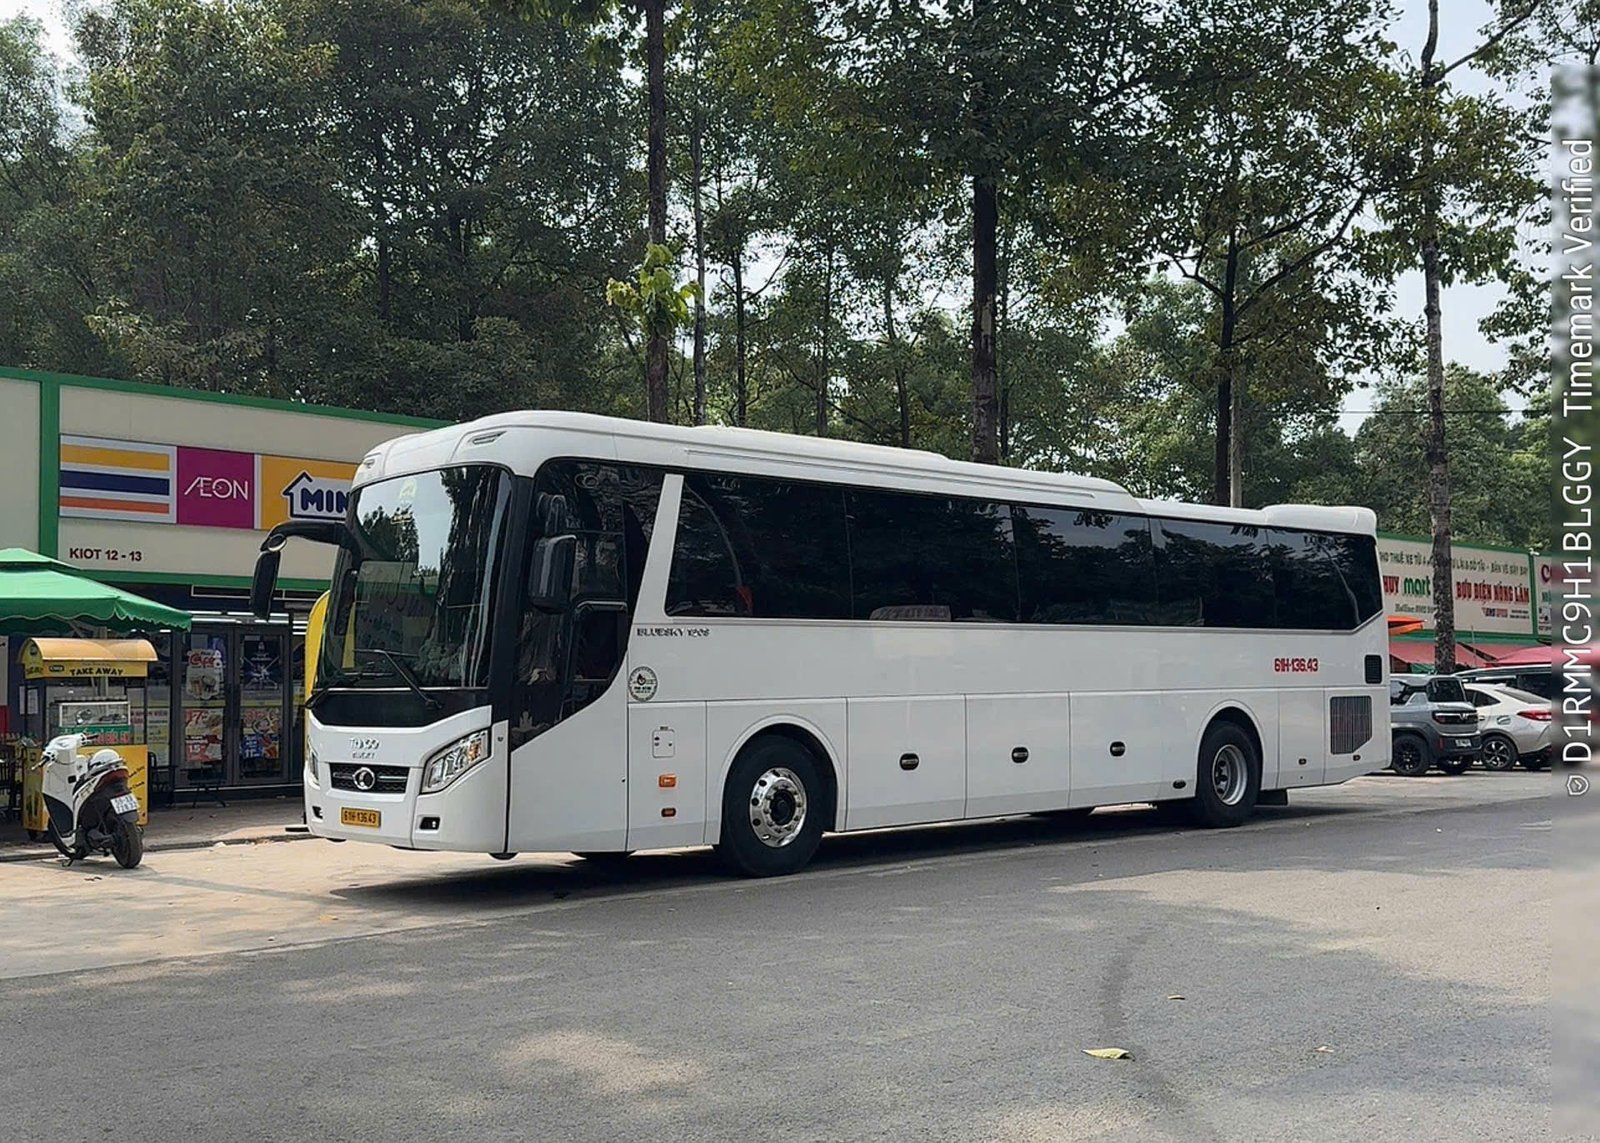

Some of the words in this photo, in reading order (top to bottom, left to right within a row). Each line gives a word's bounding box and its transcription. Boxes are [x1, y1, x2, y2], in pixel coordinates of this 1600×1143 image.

[69, 548, 101, 560] KIOT
[105, 549, 118, 561] 12
[129, 550, 142, 562] 13
[1404, 575, 1431, 596] mart
[636, 627, 684, 637] BLUESKY
[70, 668, 95, 676] TAKE
[95, 667, 124, 676] AWAY
[1274, 657, 1319, 672] 61H-136.43
